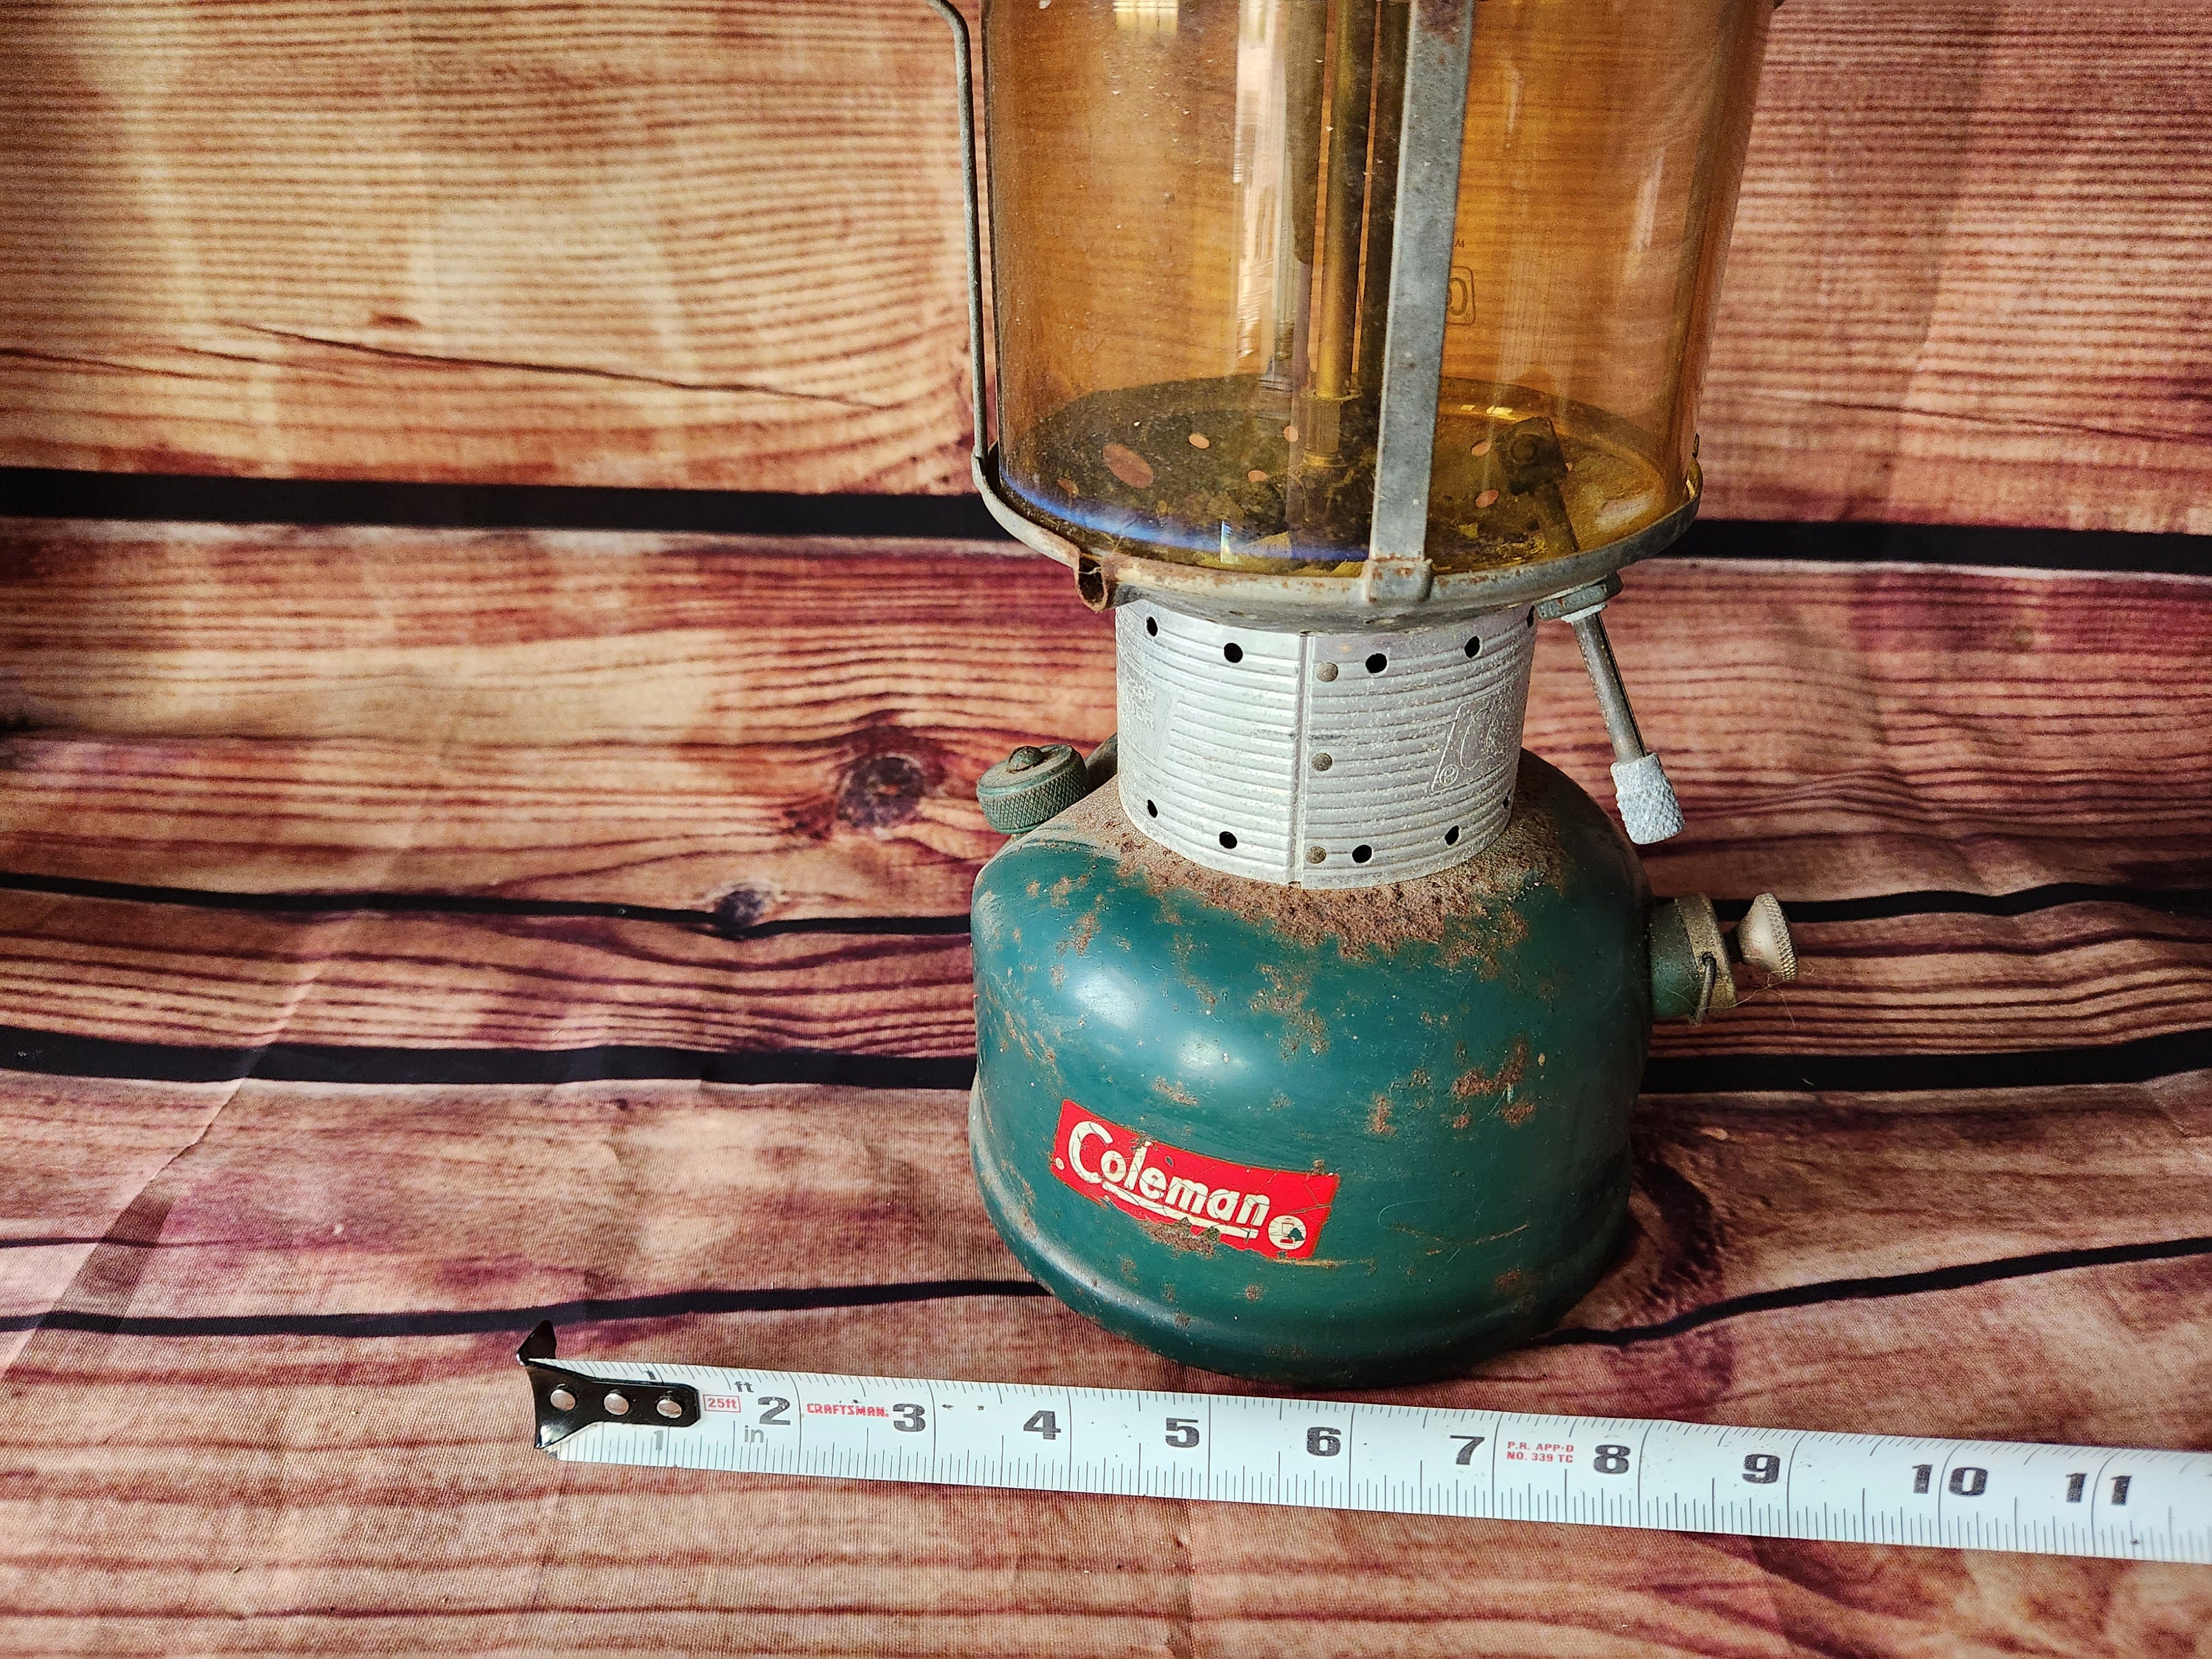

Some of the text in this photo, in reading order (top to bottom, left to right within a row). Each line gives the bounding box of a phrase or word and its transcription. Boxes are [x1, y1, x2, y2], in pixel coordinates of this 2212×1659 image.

[1068, 1121, 1270, 1227] Coleman
[734, 1381, 754, 1393] ft
[708, 1397, 737, 1409] 25ft
[758, 1397, 791, 1425] 2
[893, 1403, 926, 1432] 3
[744, 1425, 764, 1443] in
[1023, 1410, 1061, 1440] 4
[1165, 1417, 1200, 1448] 5
[1306, 1427, 1342, 1457] 6
[1450, 1435, 1485, 1465] 7
[1506, 1451, 1573, 1463] NO. 339 TC
[1593, 1444, 1631, 1474] 8
[1742, 1454, 1781, 1484] 9
[1911, 1464, 1988, 1497] 10
[2065, 1472, 2132, 1506] 11
